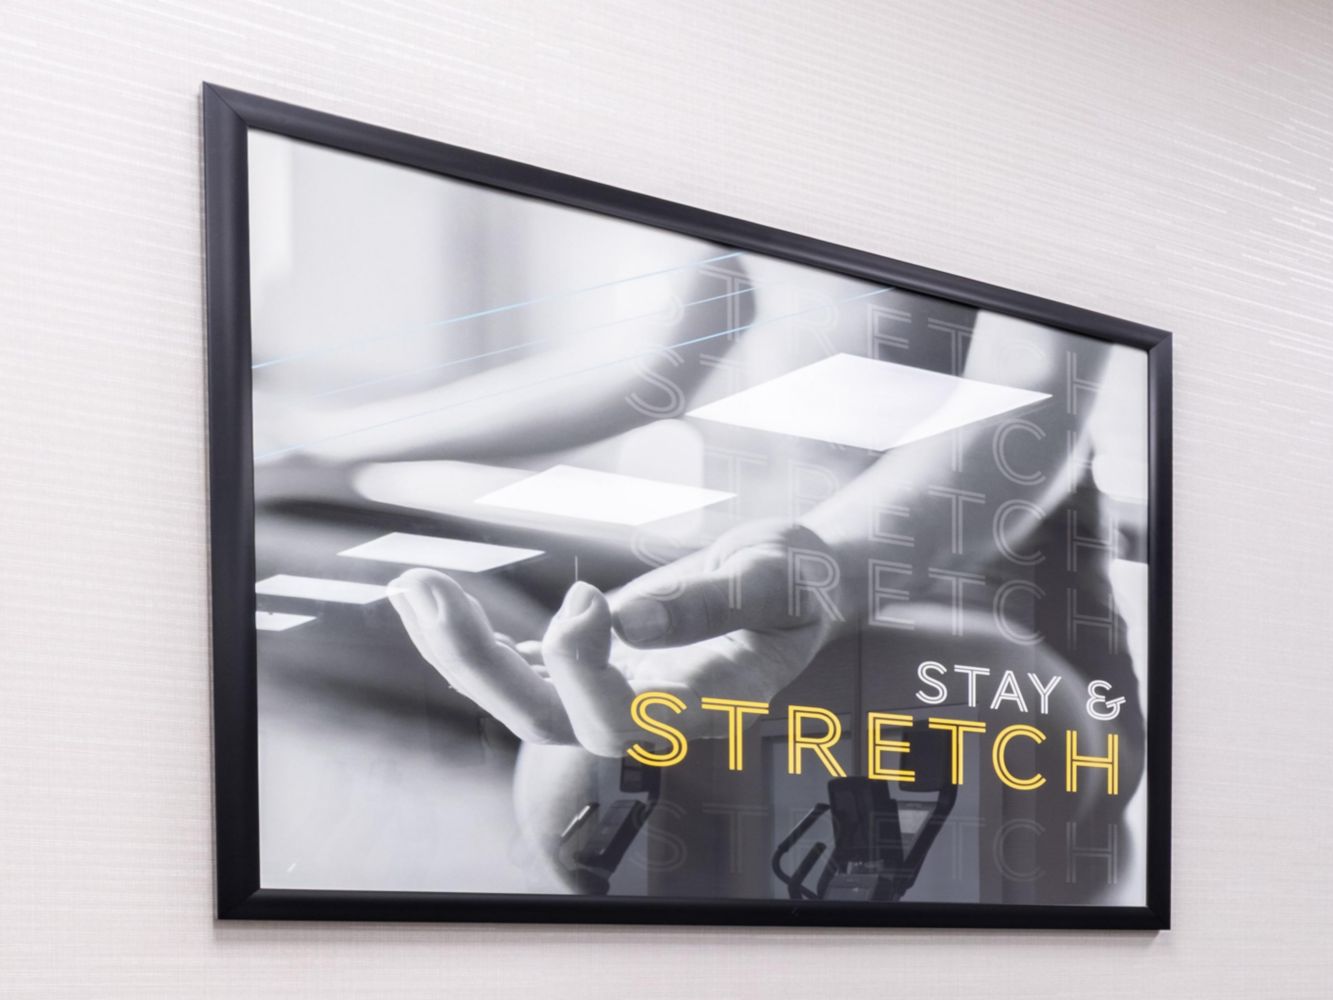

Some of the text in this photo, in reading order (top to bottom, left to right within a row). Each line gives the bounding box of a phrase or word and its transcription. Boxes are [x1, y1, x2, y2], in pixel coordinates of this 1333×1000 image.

[915, 661, 1126, 721] STAY &
[626, 691, 1120, 796] STRETCH
